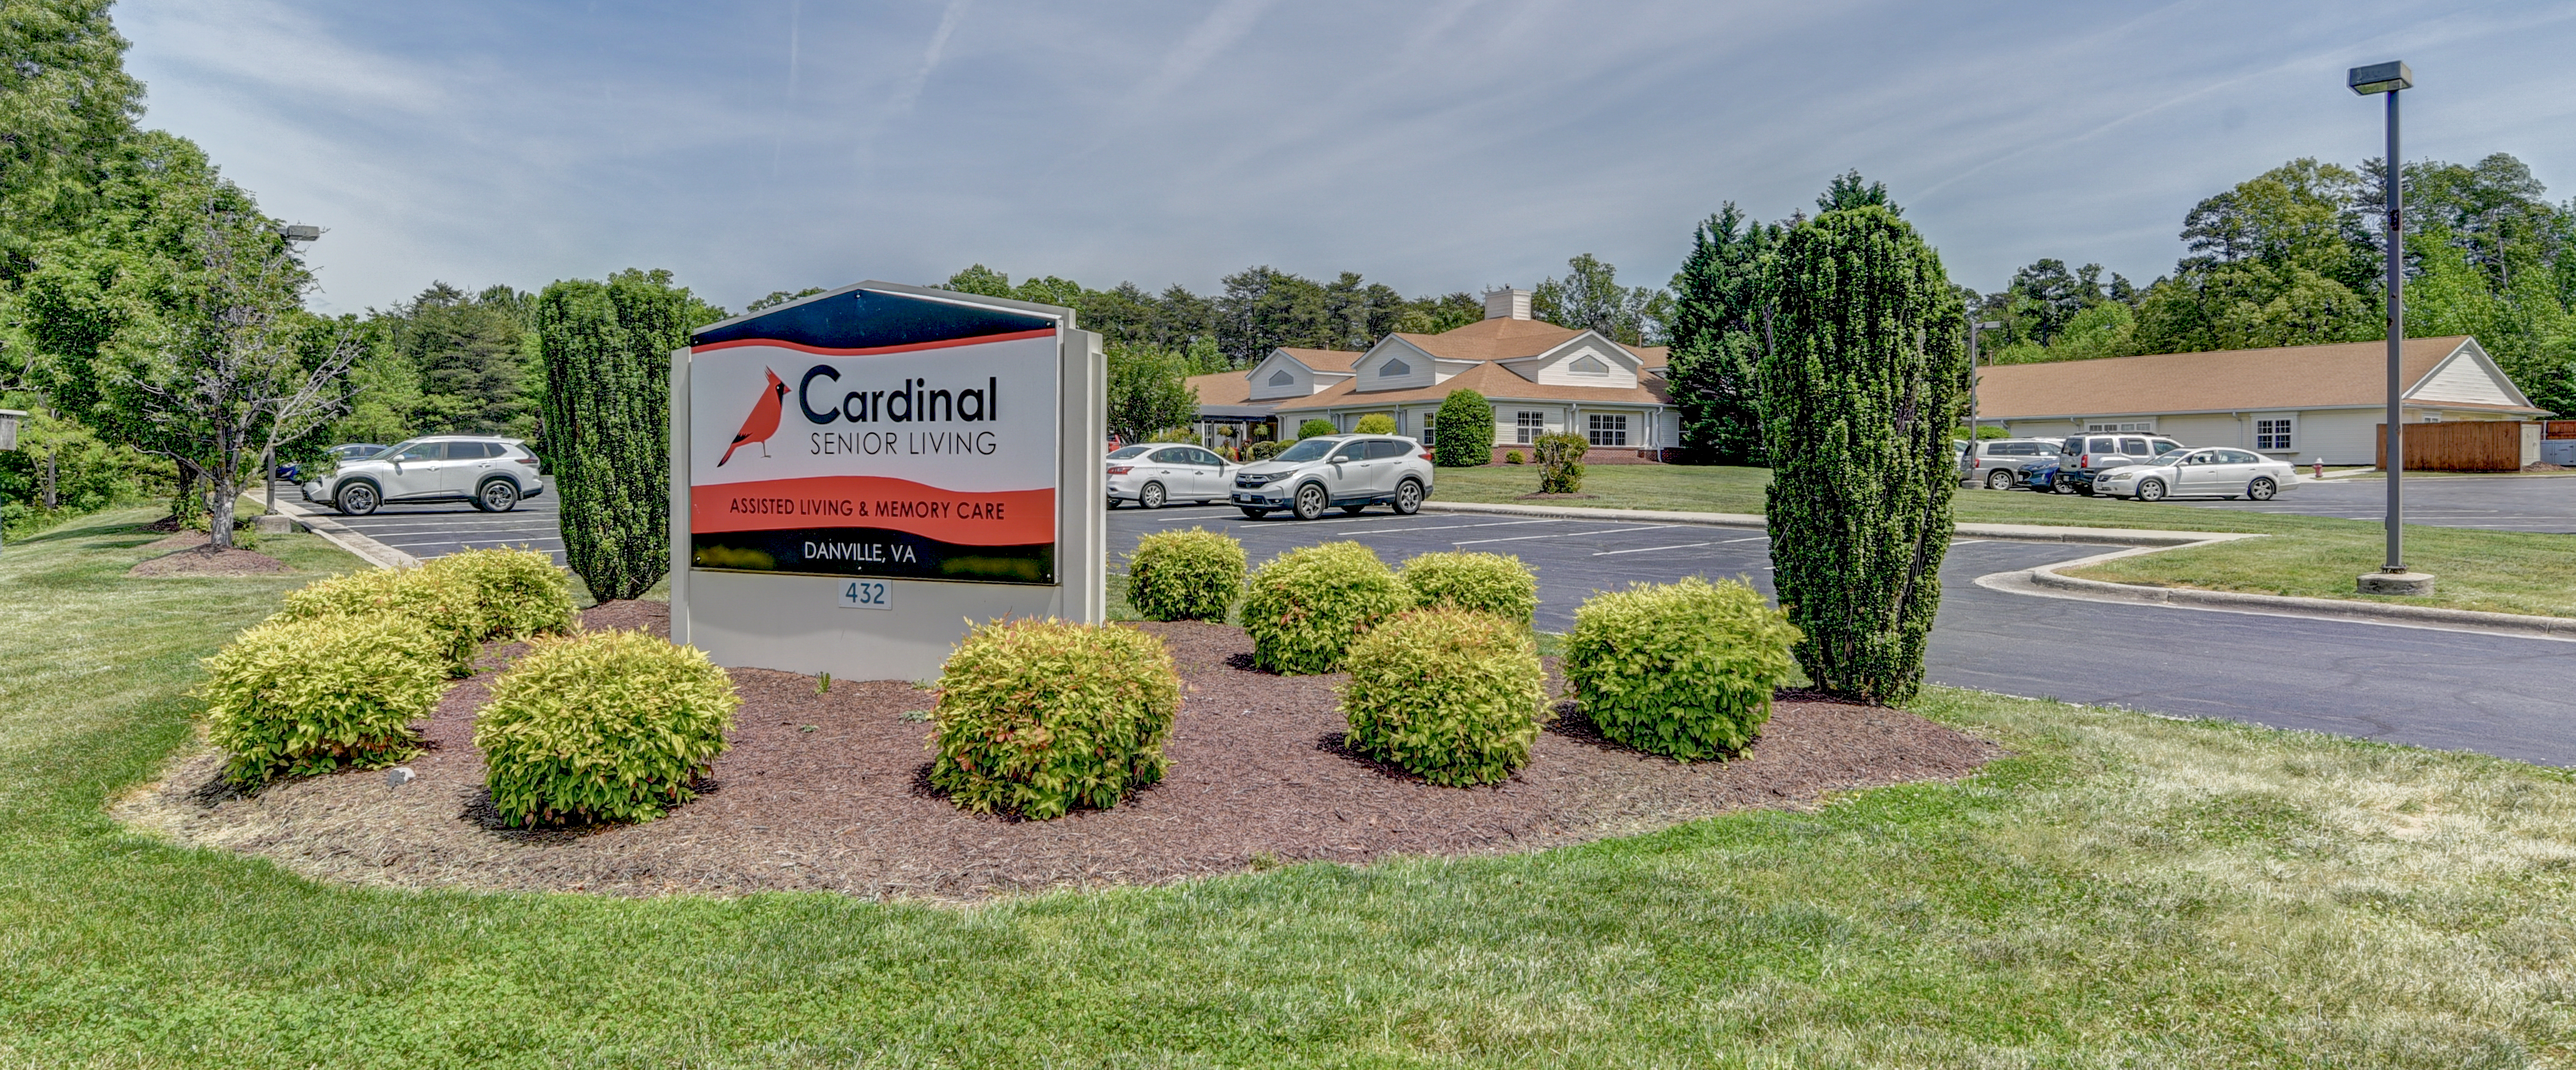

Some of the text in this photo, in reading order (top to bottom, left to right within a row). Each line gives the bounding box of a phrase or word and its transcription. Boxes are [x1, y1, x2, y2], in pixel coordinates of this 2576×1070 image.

[799, 364, 997, 425] Cardinal
[810, 431, 997, 455] SENIOR LIVING
[729, 497, 1005, 521] ASSISTED LIVING & MEMORY CARE
[804, 541, 916, 564] DANVILLE, VA
[845, 583, 885, 605] 432
